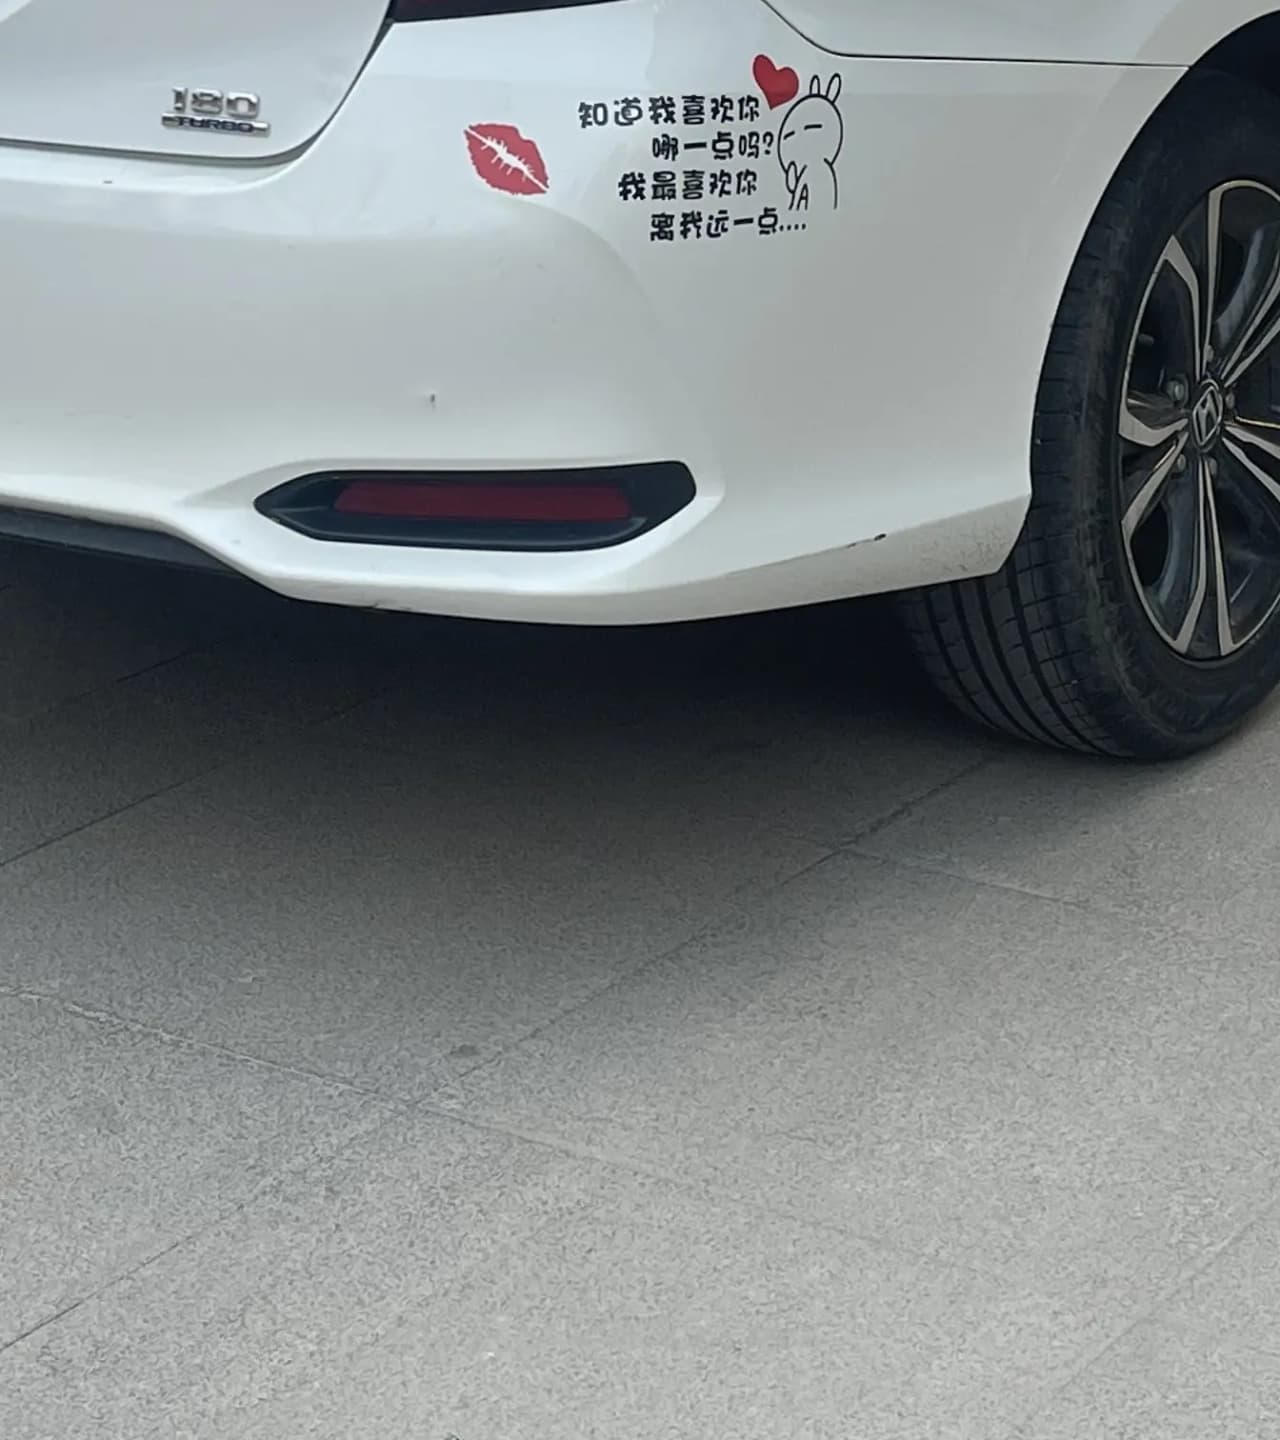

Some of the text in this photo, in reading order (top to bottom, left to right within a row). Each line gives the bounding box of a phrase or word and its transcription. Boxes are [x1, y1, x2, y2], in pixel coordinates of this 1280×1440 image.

[172, 87, 260, 119] 180
[578, 94, 760, 128] 知道我喜欢你
[652, 131, 774, 160] 哪一点吗?
[618, 168, 757, 201] 我最喜欢你
